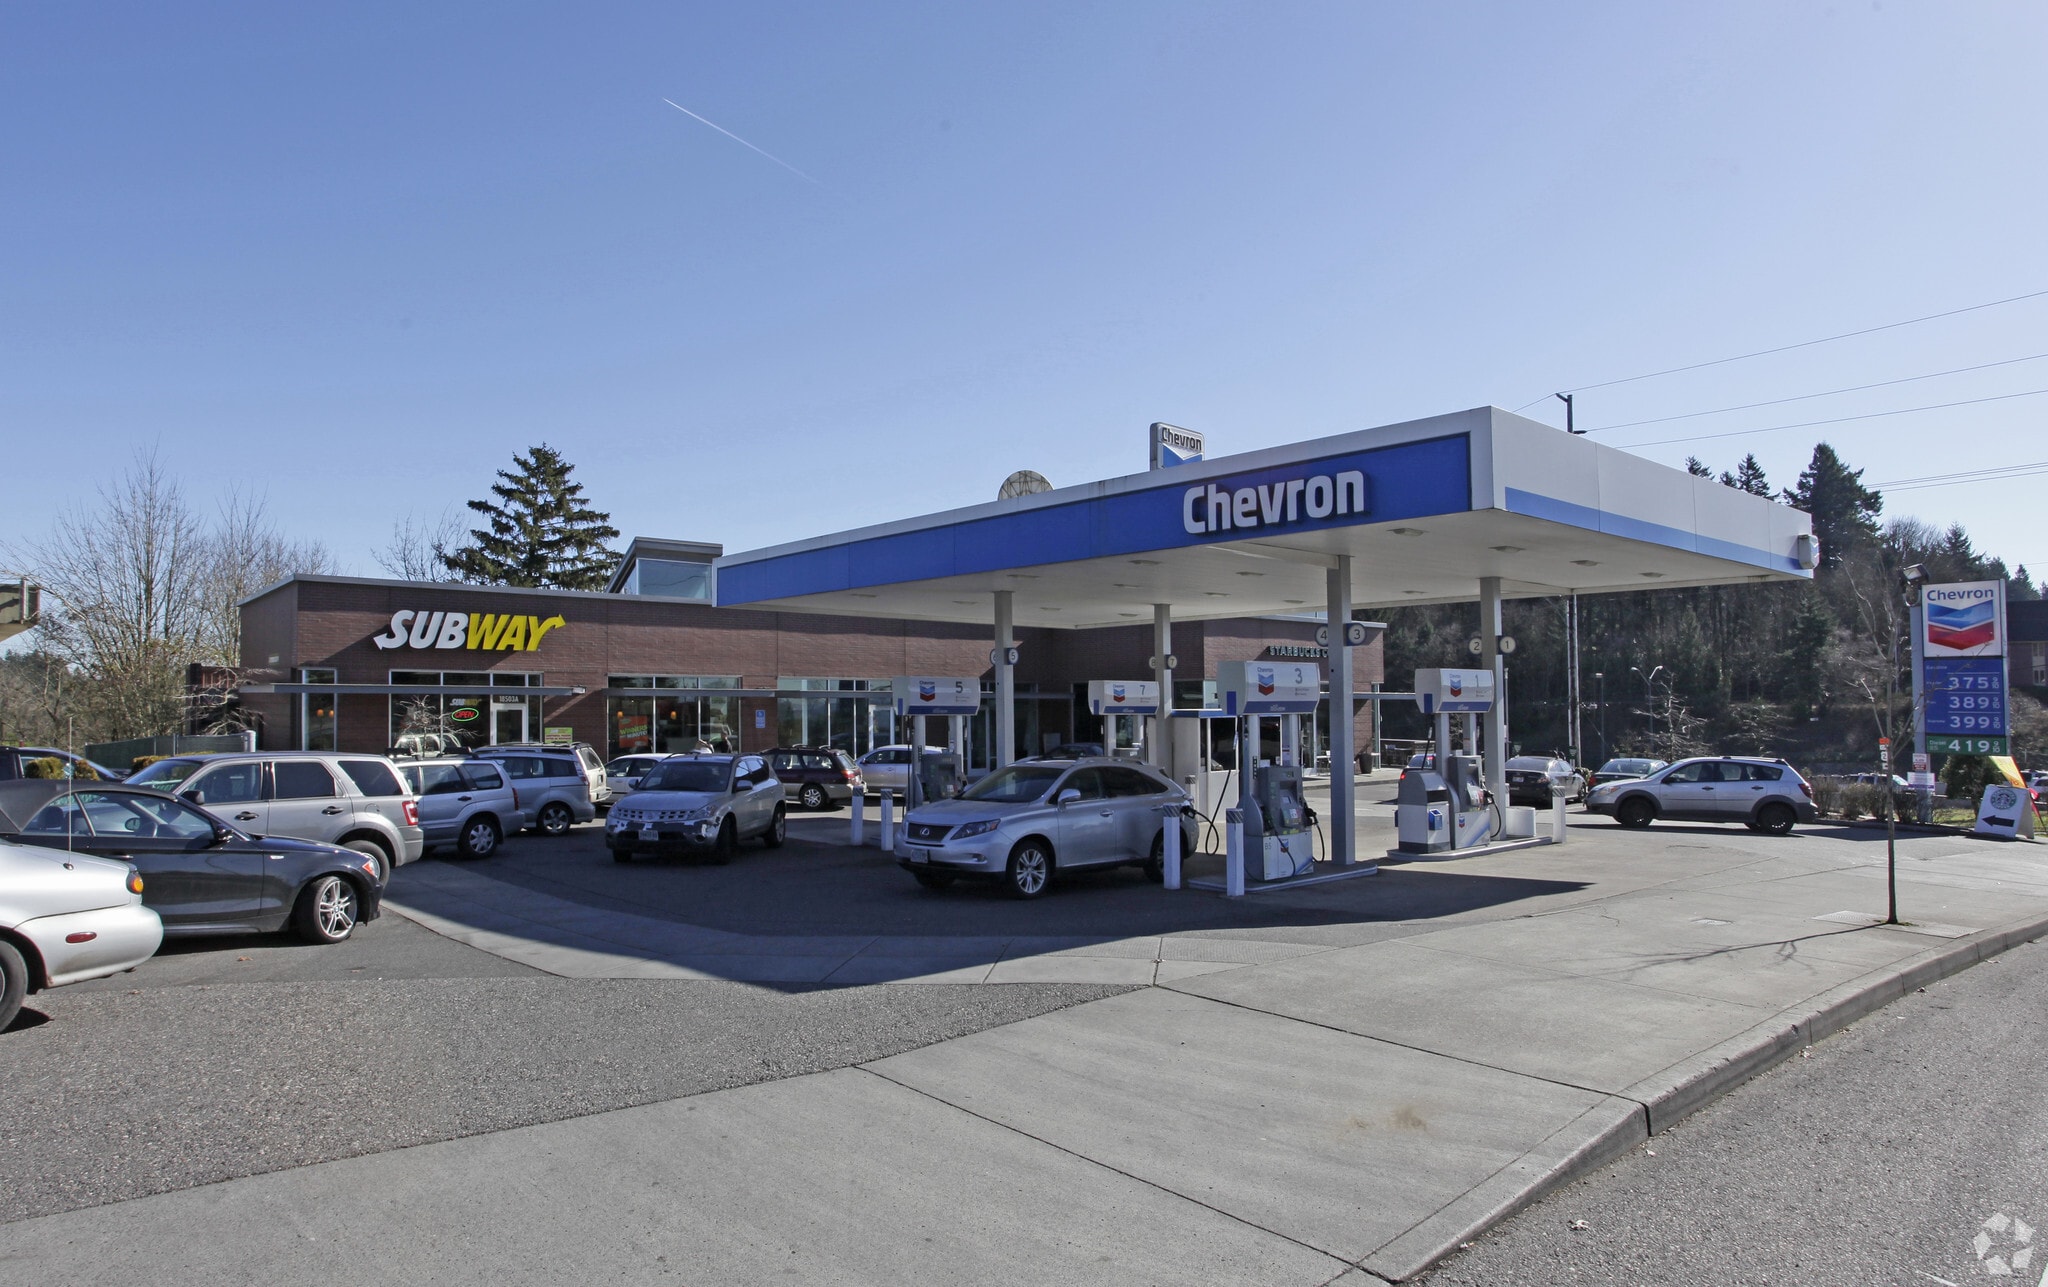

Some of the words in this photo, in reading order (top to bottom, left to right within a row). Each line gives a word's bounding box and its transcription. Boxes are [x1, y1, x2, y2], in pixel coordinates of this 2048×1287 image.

[1161, 427, 1202, 451] Chevron
[1183, 471, 1364, 534] Chevron
[1927, 589, 1994, 601] Chevron
[373, 610, 566, 651] SUBWAY
[1320, 630, 1327, 640] 4
[1354, 629, 1361, 640] 3
[1473, 641, 1480, 651] 2
[1505, 640, 1510, 649] 1
[1011, 651, 1016, 661] 5
[1269, 645, 1321, 658] STARBUCKS
[1171, 658, 1176, 666] 7
[1295, 668, 1303, 684] 3
[1475, 674, 1479, 688] 1
[955, 681, 963, 694] 5
[1949, 677, 1989, 689] 375
[1140, 685, 1146, 695] 7
[1949, 696, 1990, 709] 389
[454, 710, 475, 719] OPEN
[1950, 716, 1990, 729] 399
[1948, 740, 1990, 752] 419
